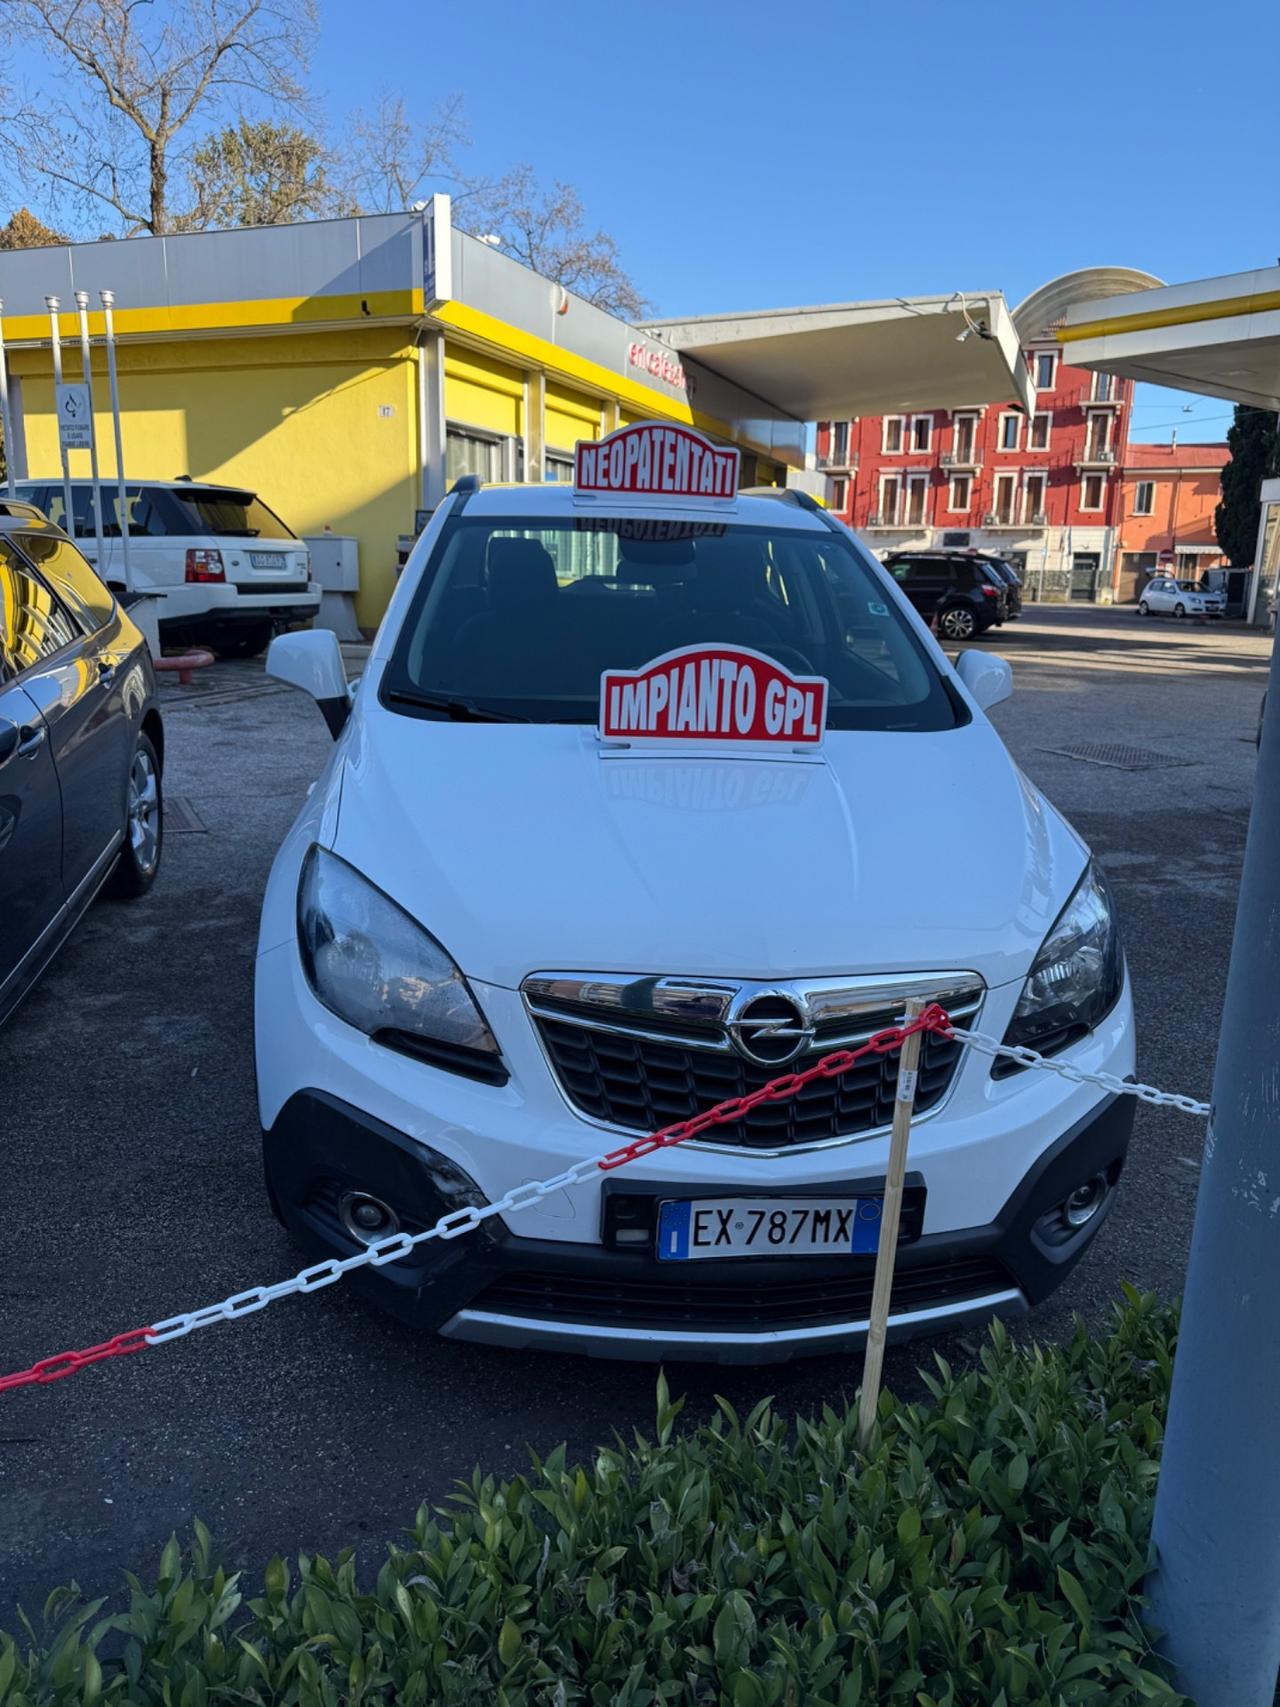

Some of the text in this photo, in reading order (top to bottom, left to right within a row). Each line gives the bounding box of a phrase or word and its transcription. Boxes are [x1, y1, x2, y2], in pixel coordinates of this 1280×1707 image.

[581, 428, 733, 495] NEOPATENTATI
[610, 658, 817, 736] IMPIANTO GPL
[693, 1209, 853, 1246] EX 787MX
